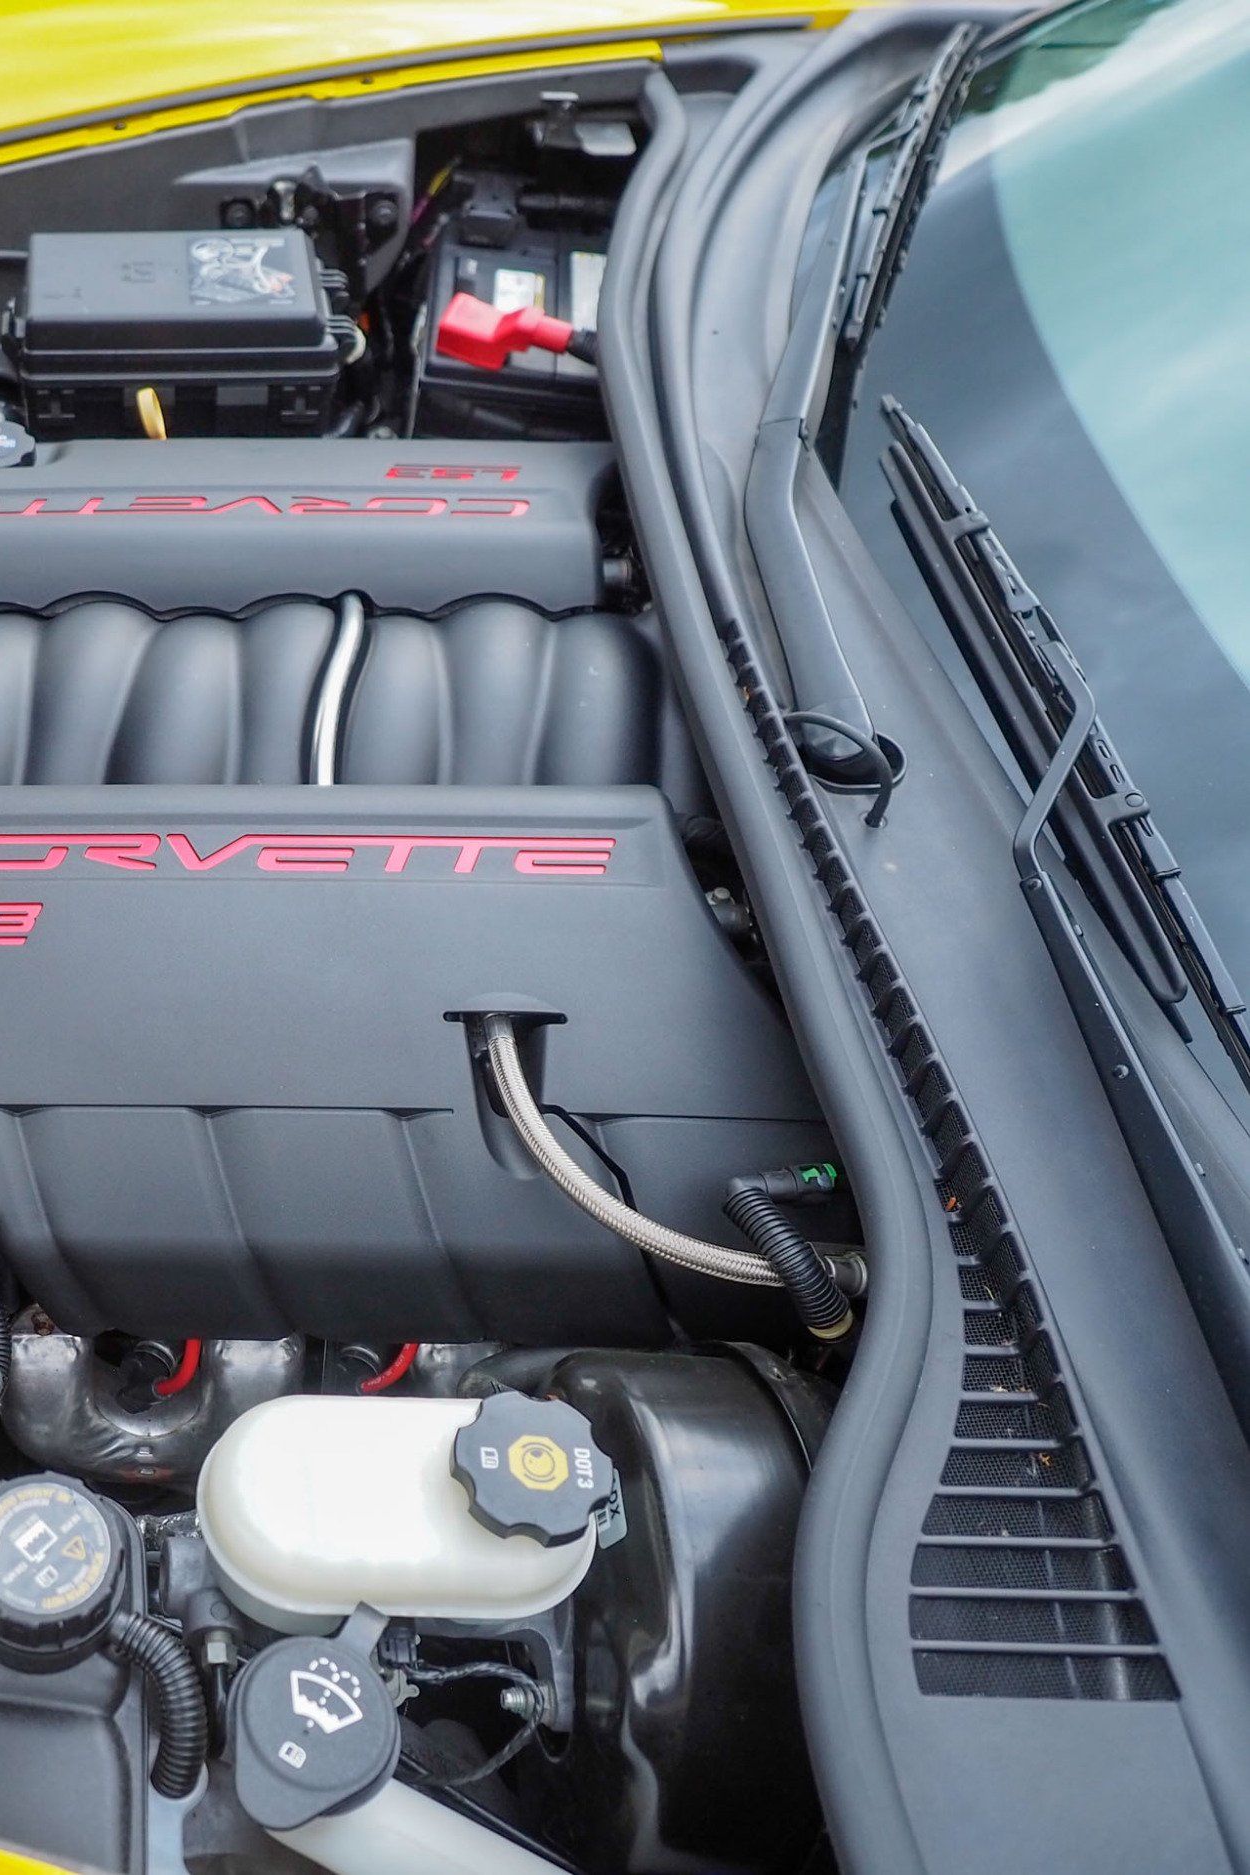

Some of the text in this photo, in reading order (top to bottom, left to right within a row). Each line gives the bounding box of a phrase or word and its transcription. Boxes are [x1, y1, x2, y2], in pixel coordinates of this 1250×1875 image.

[385, 464, 522, 481] LS3
[574, 1447, 594, 1489] DOT 3
